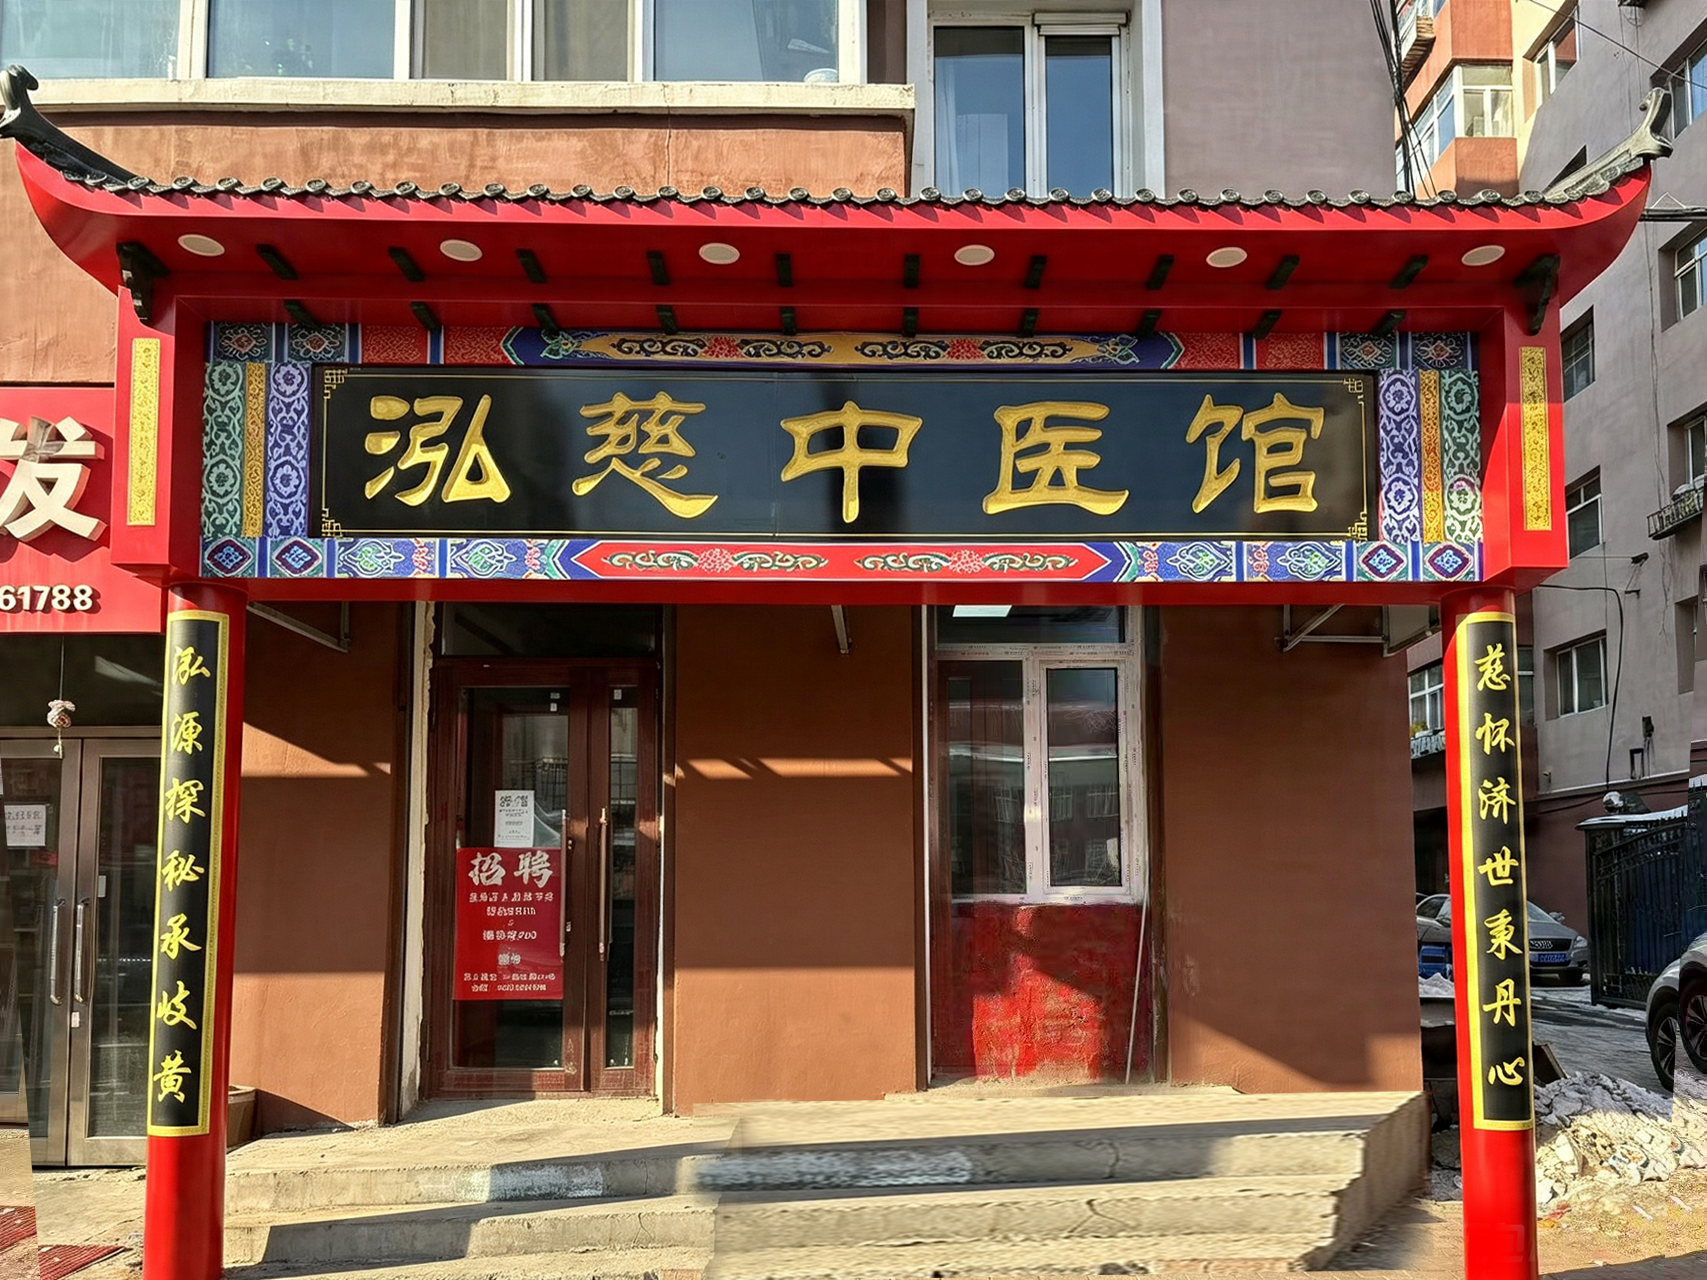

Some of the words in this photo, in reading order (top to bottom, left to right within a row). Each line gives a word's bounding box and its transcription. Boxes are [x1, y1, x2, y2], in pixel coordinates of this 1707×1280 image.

[0, 416, 106, 541] 发
[364, 391, 1326, 524] 泓慈中医馆
[0, 584, 94, 611] 61788
[468, 851, 554, 889] 招聘
[1474, 643, 1527, 1086] 慈怀济世秉丹心
